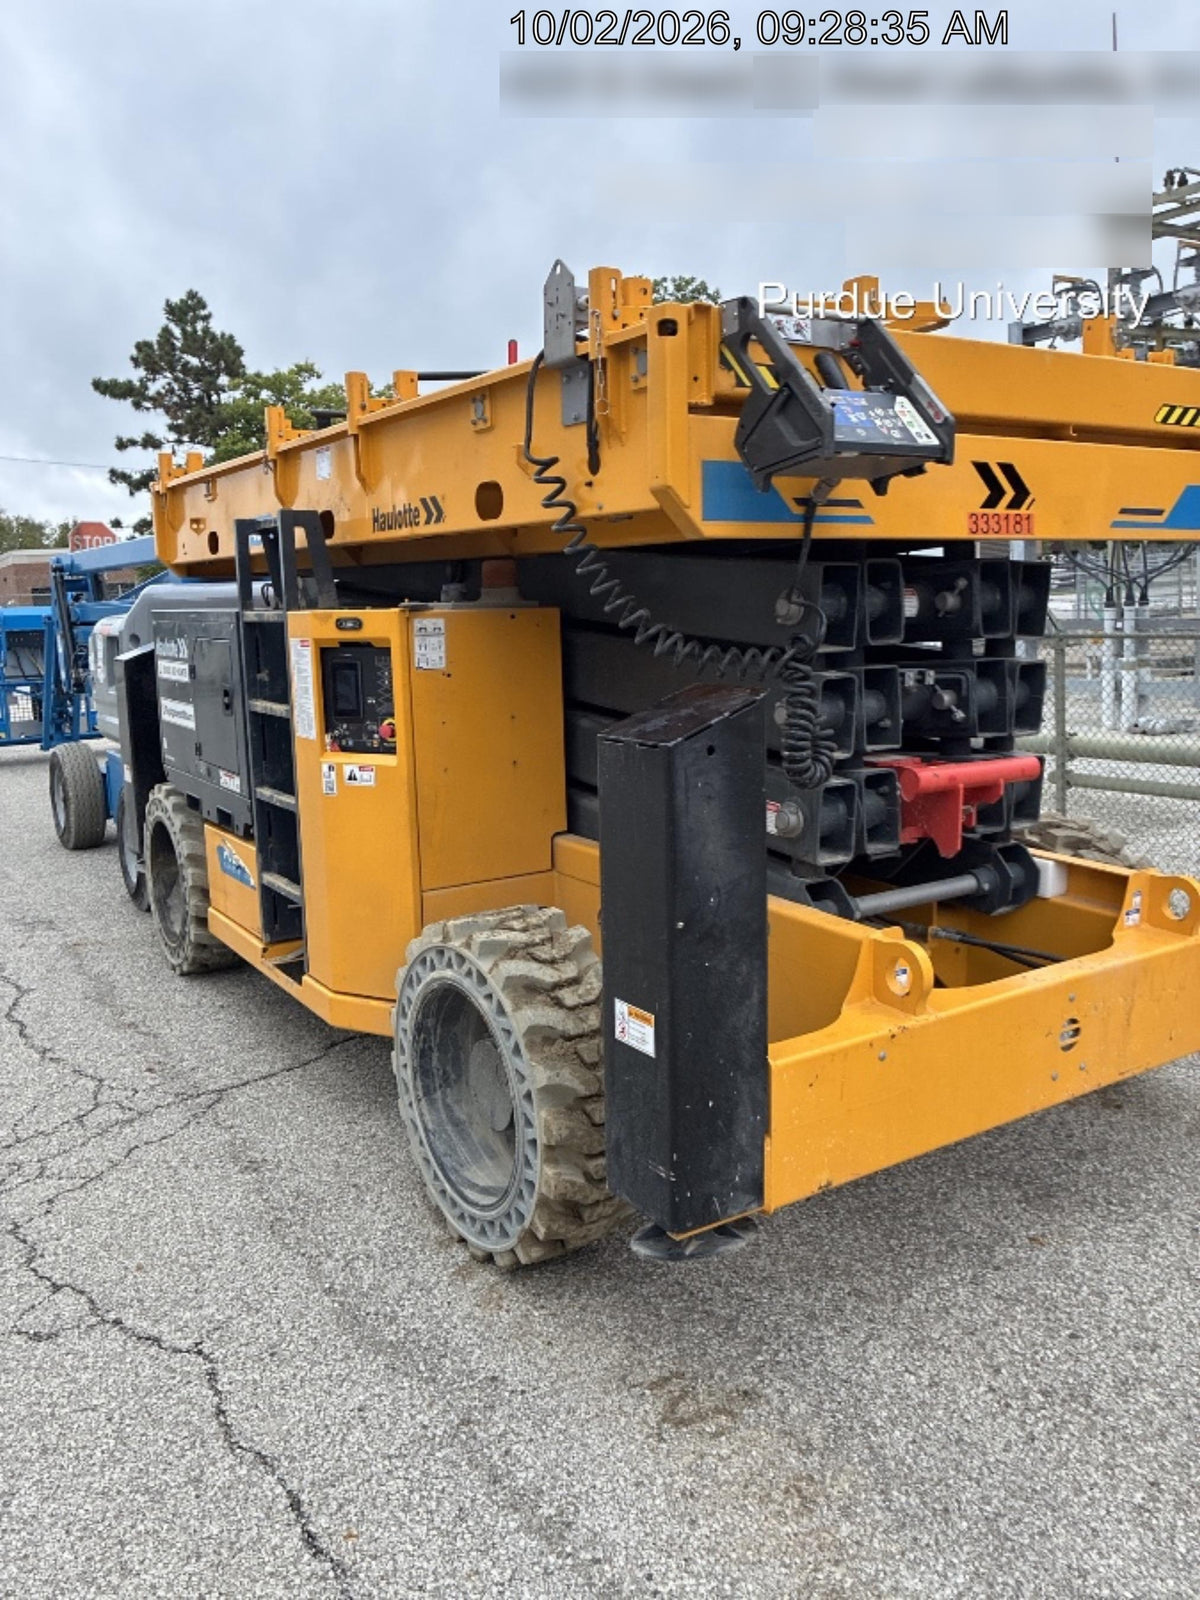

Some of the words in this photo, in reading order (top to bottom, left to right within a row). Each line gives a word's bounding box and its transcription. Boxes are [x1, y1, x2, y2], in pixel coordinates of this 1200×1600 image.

[372, 502, 421, 534] Haulotte
[968, 512, 1031, 535] 333181
[73, 534, 113, 550] STOP
